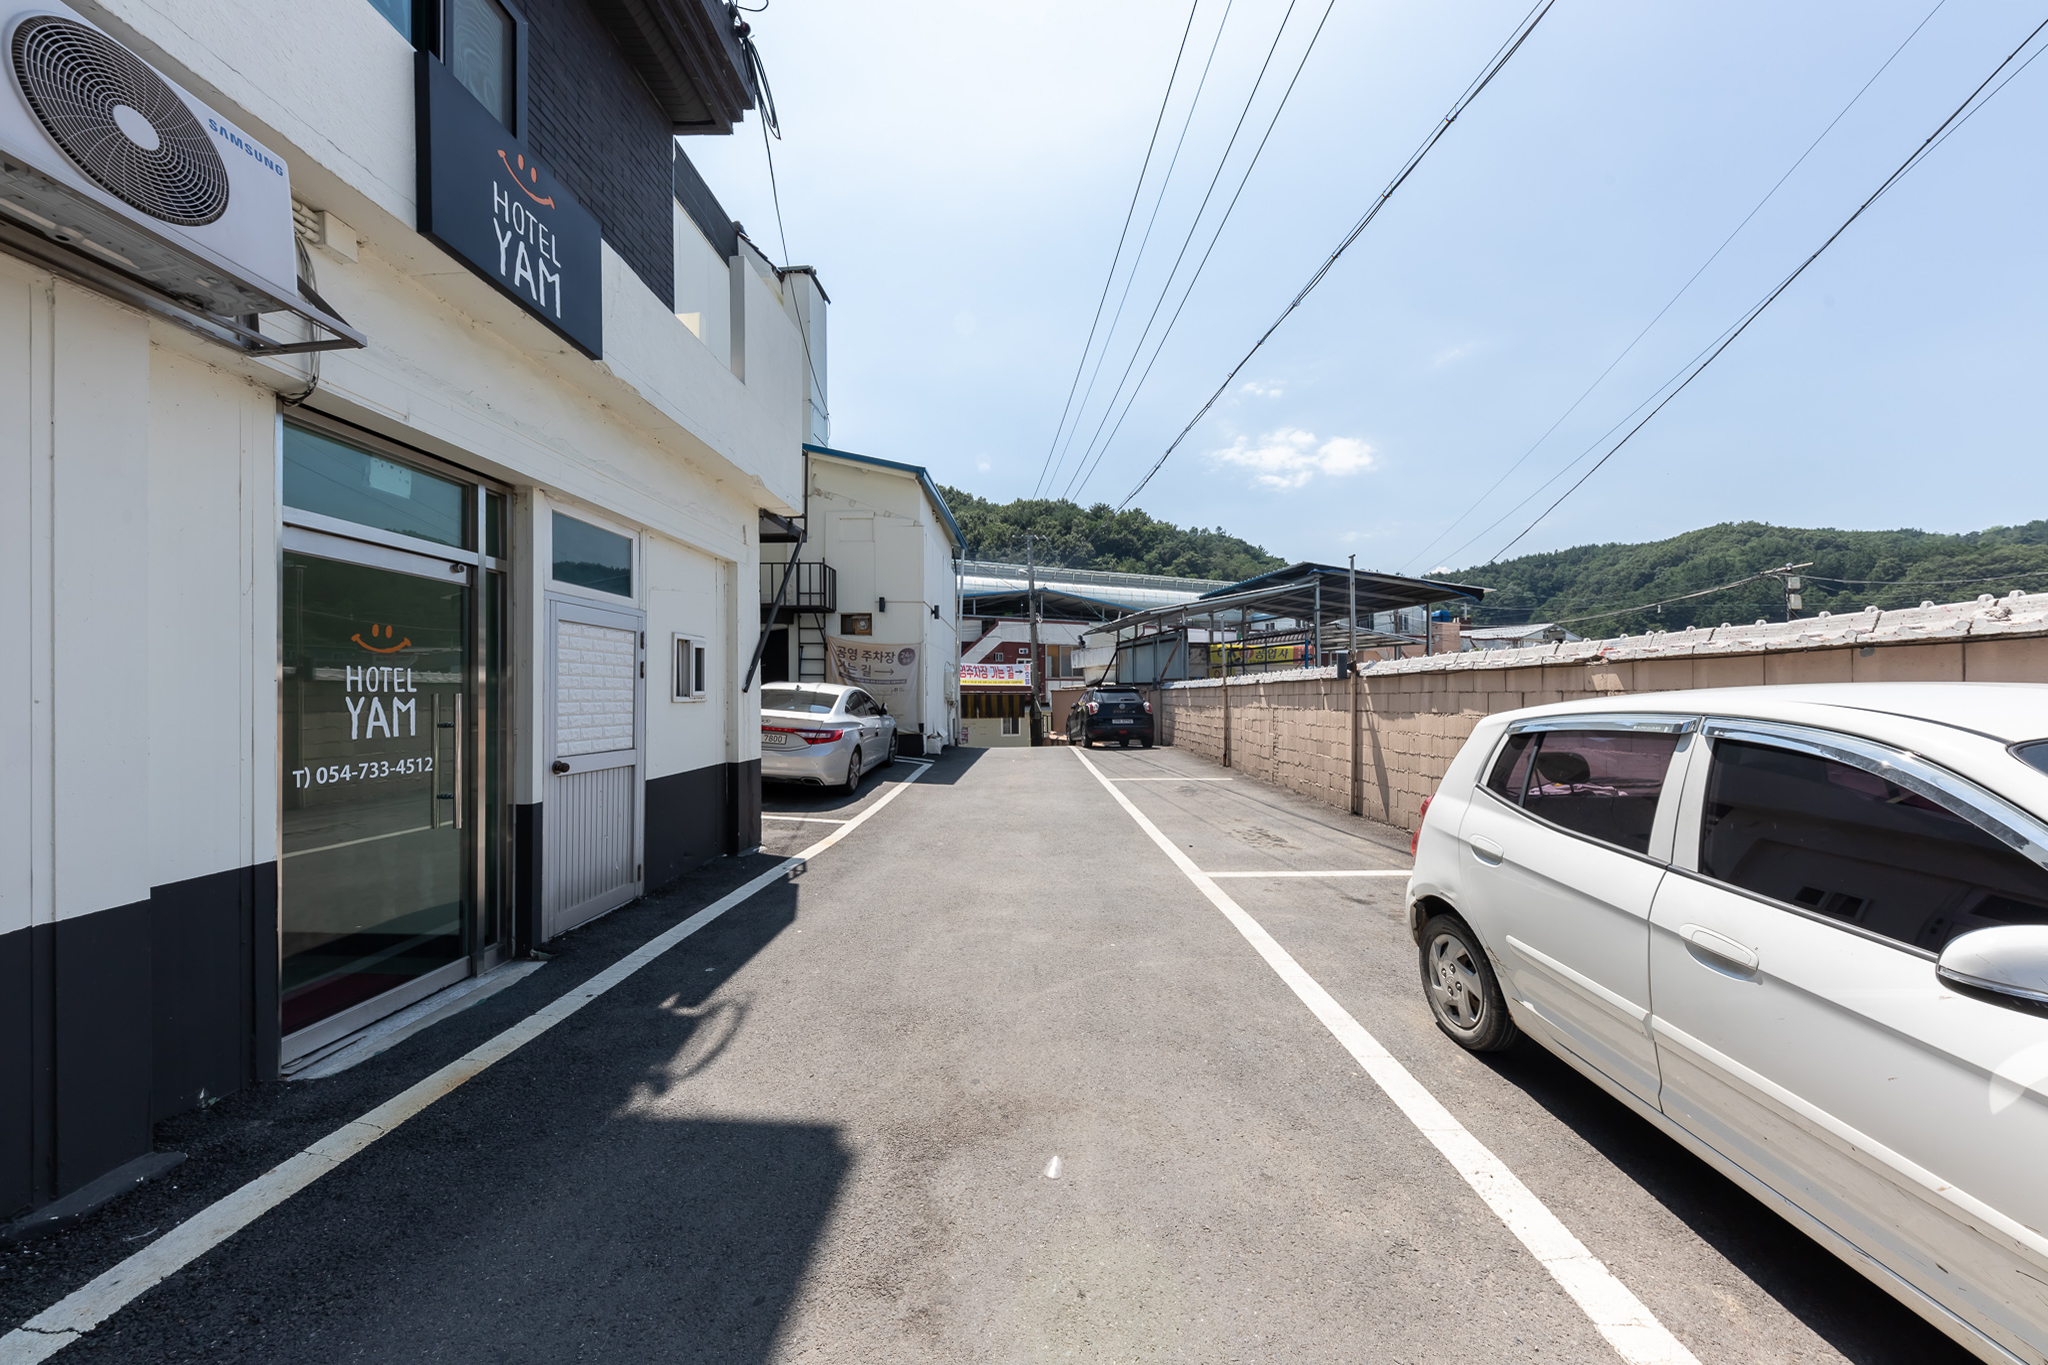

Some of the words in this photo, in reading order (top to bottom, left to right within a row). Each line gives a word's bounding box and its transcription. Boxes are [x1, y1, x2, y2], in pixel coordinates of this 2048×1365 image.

[208, 118, 284, 178] SAMSUNG
[493, 180, 561, 268] HOTEL
[492, 217, 562, 319] YAM
[837, 646, 858, 661] 공영
[861, 650, 896, 664] 주차장
[838, 659, 858, 676] 가는
[861, 664, 872, 678] 길
[346, 665, 417, 693] HOTEL
[990, 666, 1005, 679] 가는
[1006, 666, 1014, 679] 길
[345, 696, 416, 740] YAM
[764, 734, 783, 743] 7800
[292, 767, 311, 789] T)
[316, 756, 433, 784] 054-733-4512
